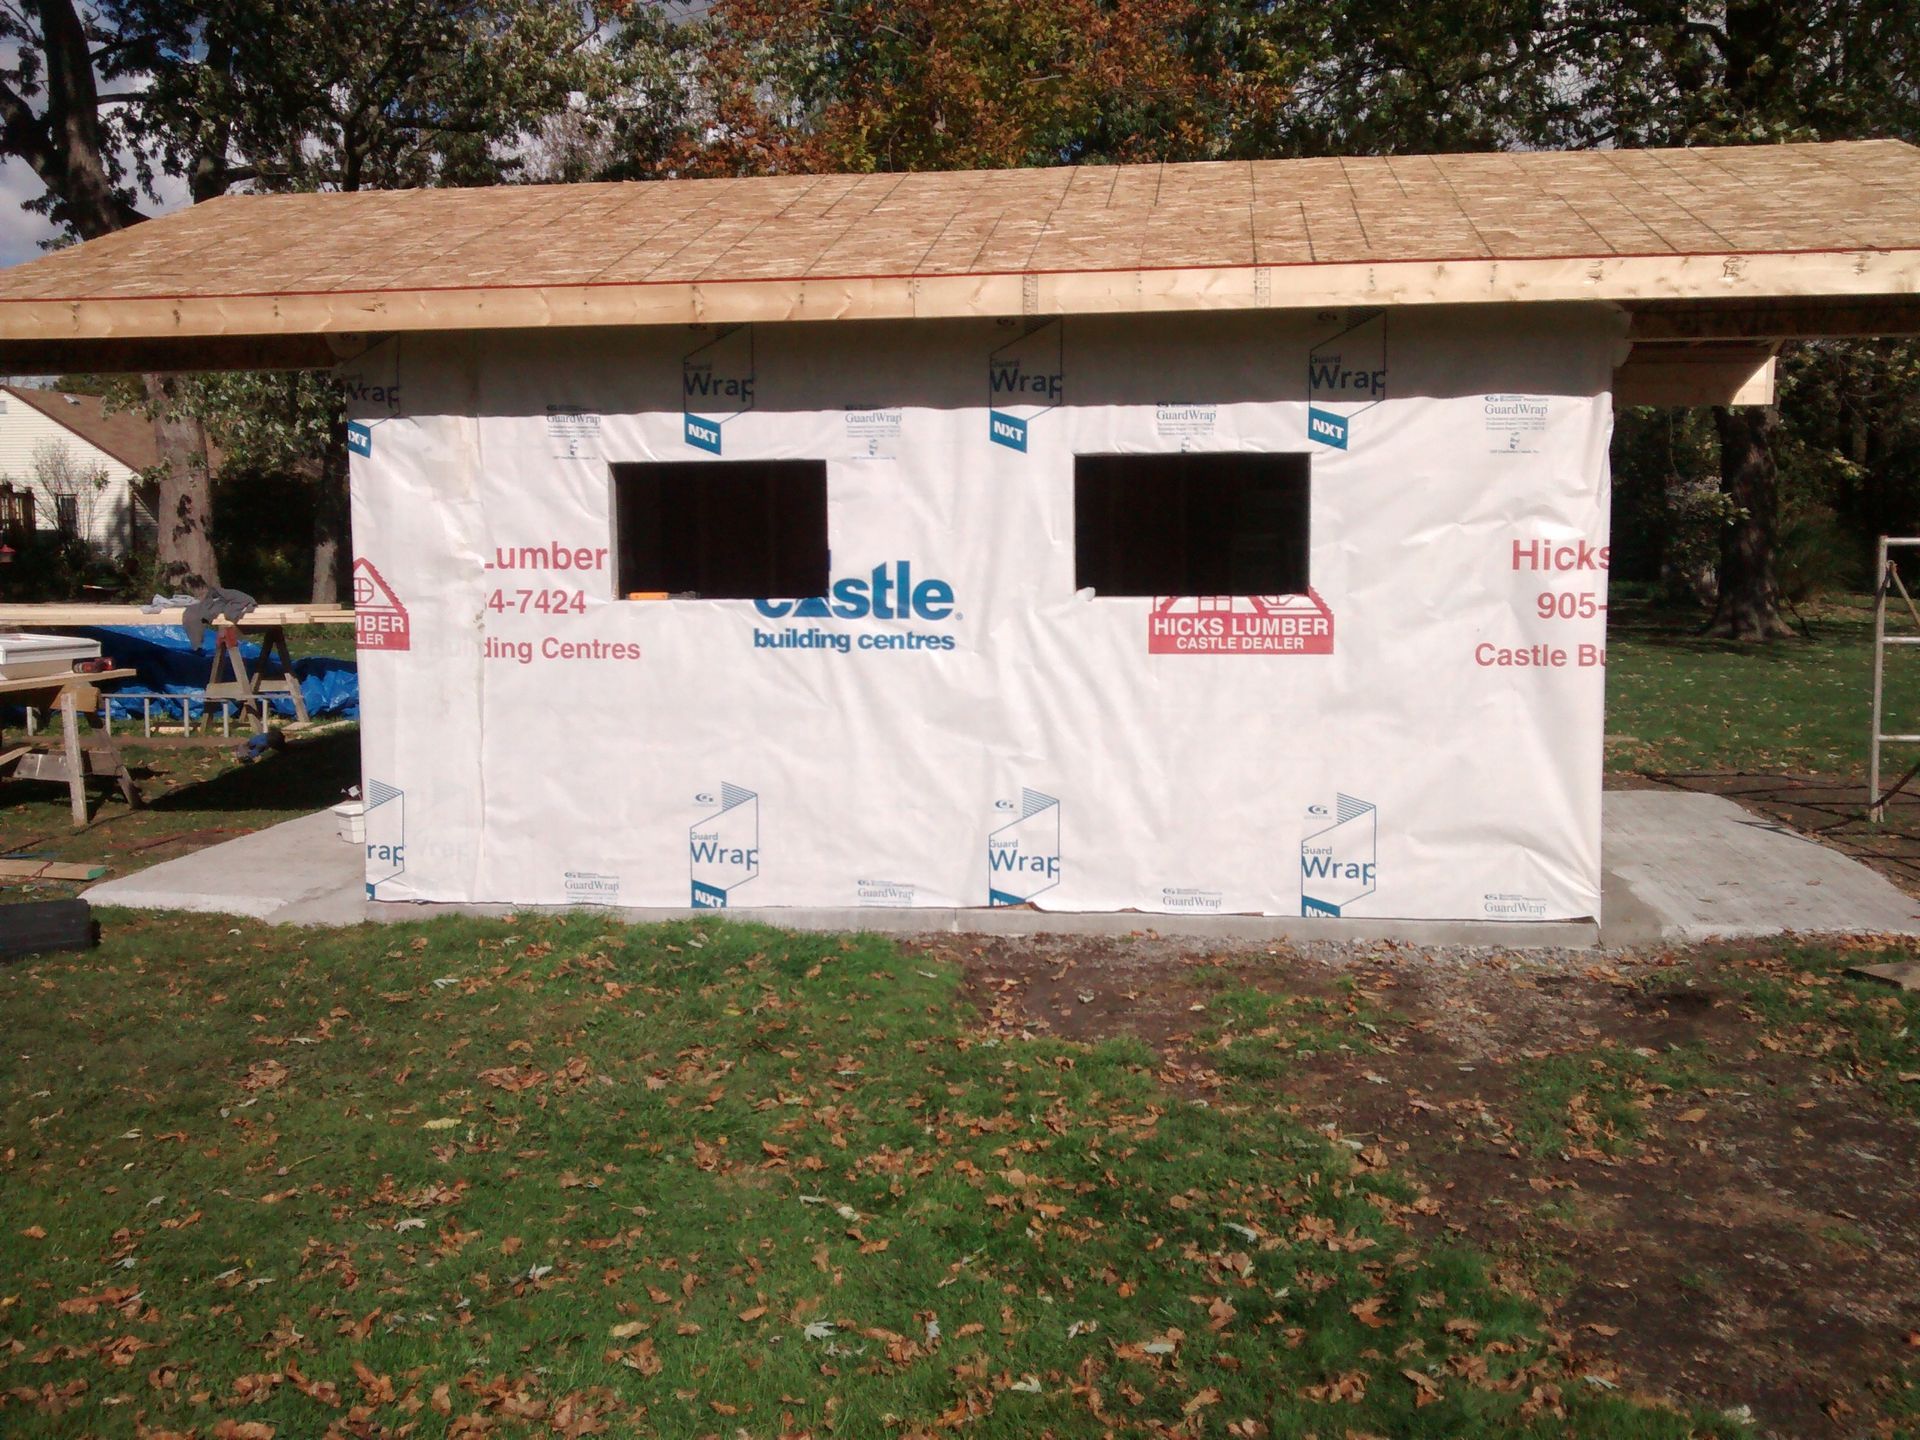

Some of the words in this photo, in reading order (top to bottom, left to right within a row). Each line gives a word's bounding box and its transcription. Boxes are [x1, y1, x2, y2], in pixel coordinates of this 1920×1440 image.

[684, 372, 754, 402] Wrap
[990, 367, 1064, 399] Wrap
[1309, 365, 1386, 395] Wrap
[546, 413, 601, 425] GuardWrap
[845, 412, 902, 425] GuardWrap
[1156, 409, 1217, 423] GuardWrap
[1484, 403, 1549, 417] GuardWrap
[688, 423, 718, 444] NXT
[994, 420, 1024, 442] NXT
[1312, 418, 1345, 440] NXT
[1512, 539, 1611, 571] Hicks
[484, 589, 587, 615] 4-7424
[1537, 592, 1608, 619] 905-
[1154, 618, 1225, 636] HICKS
[1231, 618, 1329, 636] LUMBER
[357, 633, 384, 645] LER
[754, 628, 851, 653] building
[857, 631, 956, 650] centres
[1176, 636, 1237, 650] CASTLE
[1241, 636, 1305, 650] DEALER
[484, 636, 533, 664] ding
[541, 636, 641, 660] Centres
[1474, 643, 1568, 667] Castle
[690, 832, 719, 841] Guard
[989, 839, 1019, 848] Guard
[367, 844, 404, 867] rap
[690, 842, 759, 871] Wrap
[1301, 845, 1333, 855] Guard
[989, 849, 1060, 879] Wrap
[1302, 856, 1377, 886] Wrap
[564, 880, 619, 893] GuardWrap
[857, 887, 914, 901] GuardWrap
[695, 889, 724, 908] NXT
[1162, 895, 1222, 910] GuardWrap
[1484, 902, 1547, 916] GuardWrap
